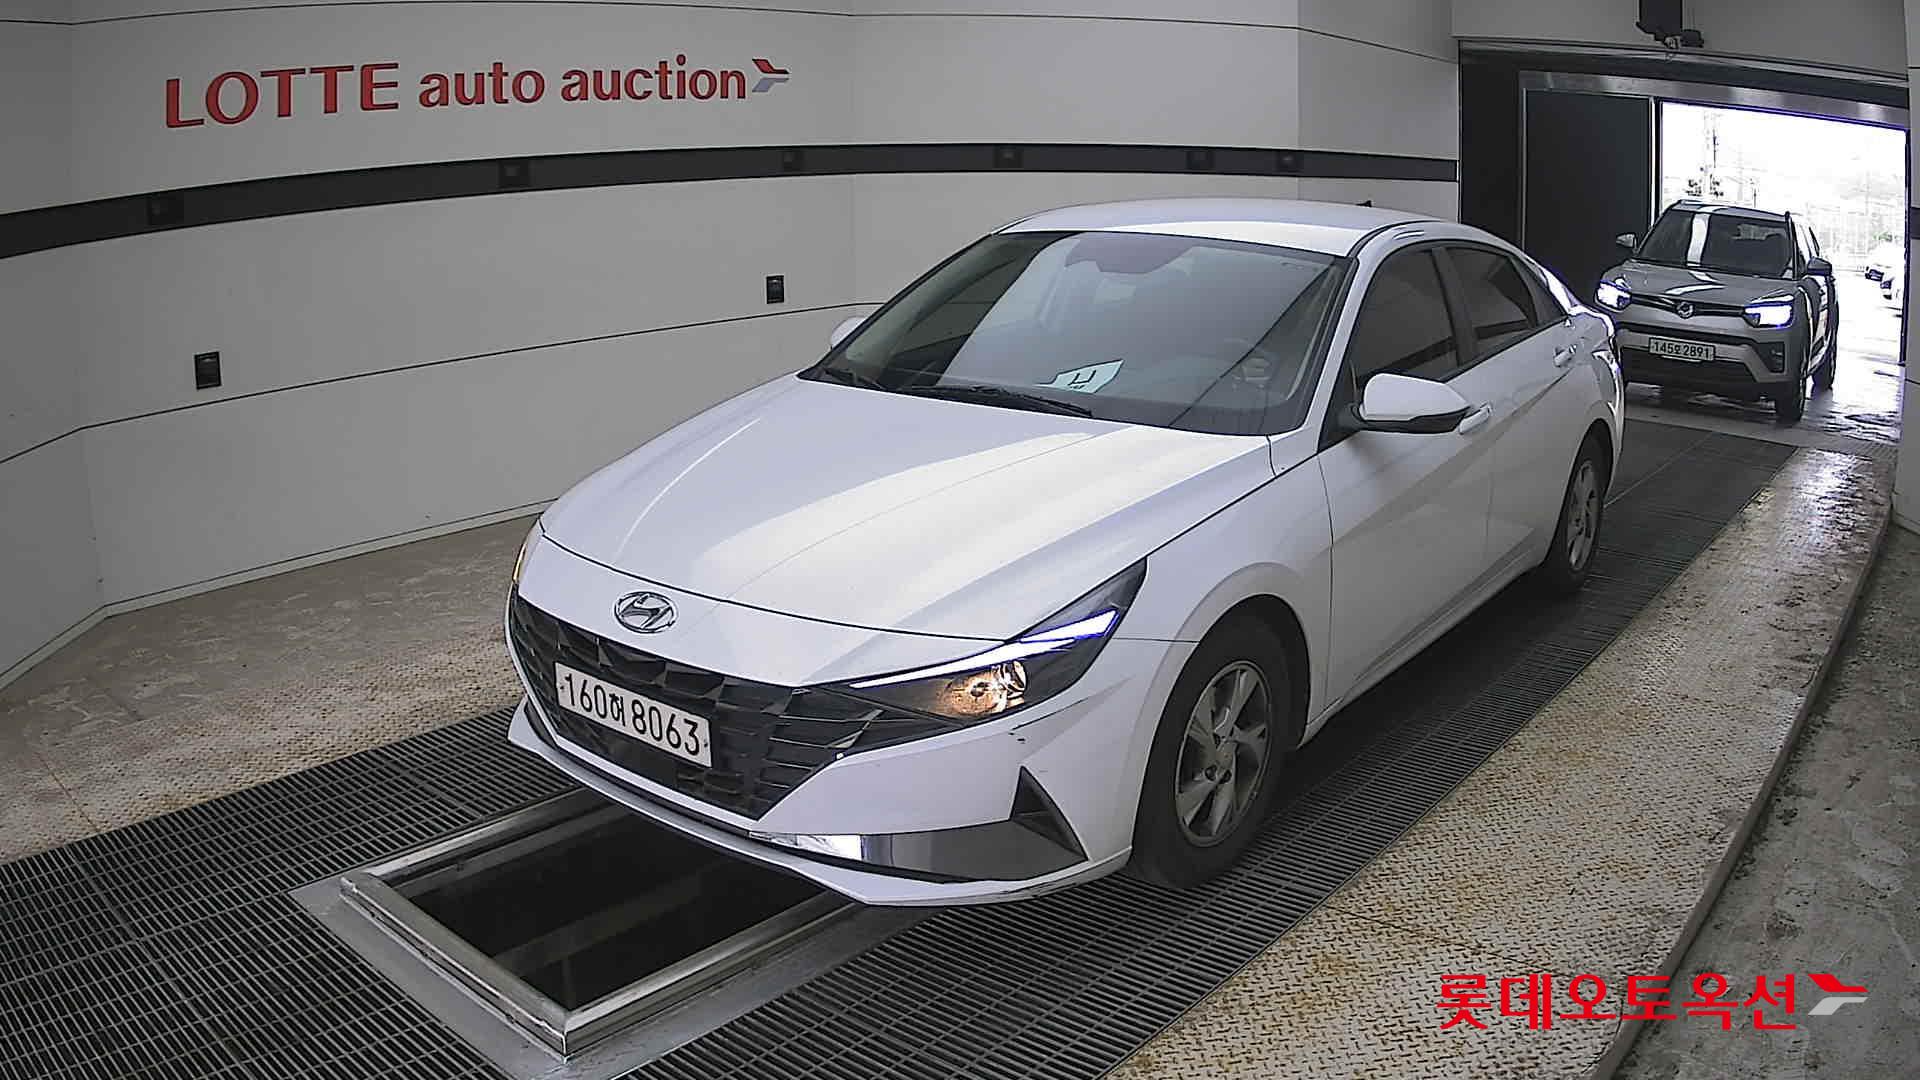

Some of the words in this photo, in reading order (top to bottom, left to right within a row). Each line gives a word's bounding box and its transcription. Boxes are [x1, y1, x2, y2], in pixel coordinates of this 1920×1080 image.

[165, 63, 400, 128] LOTTE
[418, 62, 545, 108] auto
[561, 53, 748, 102] auction
